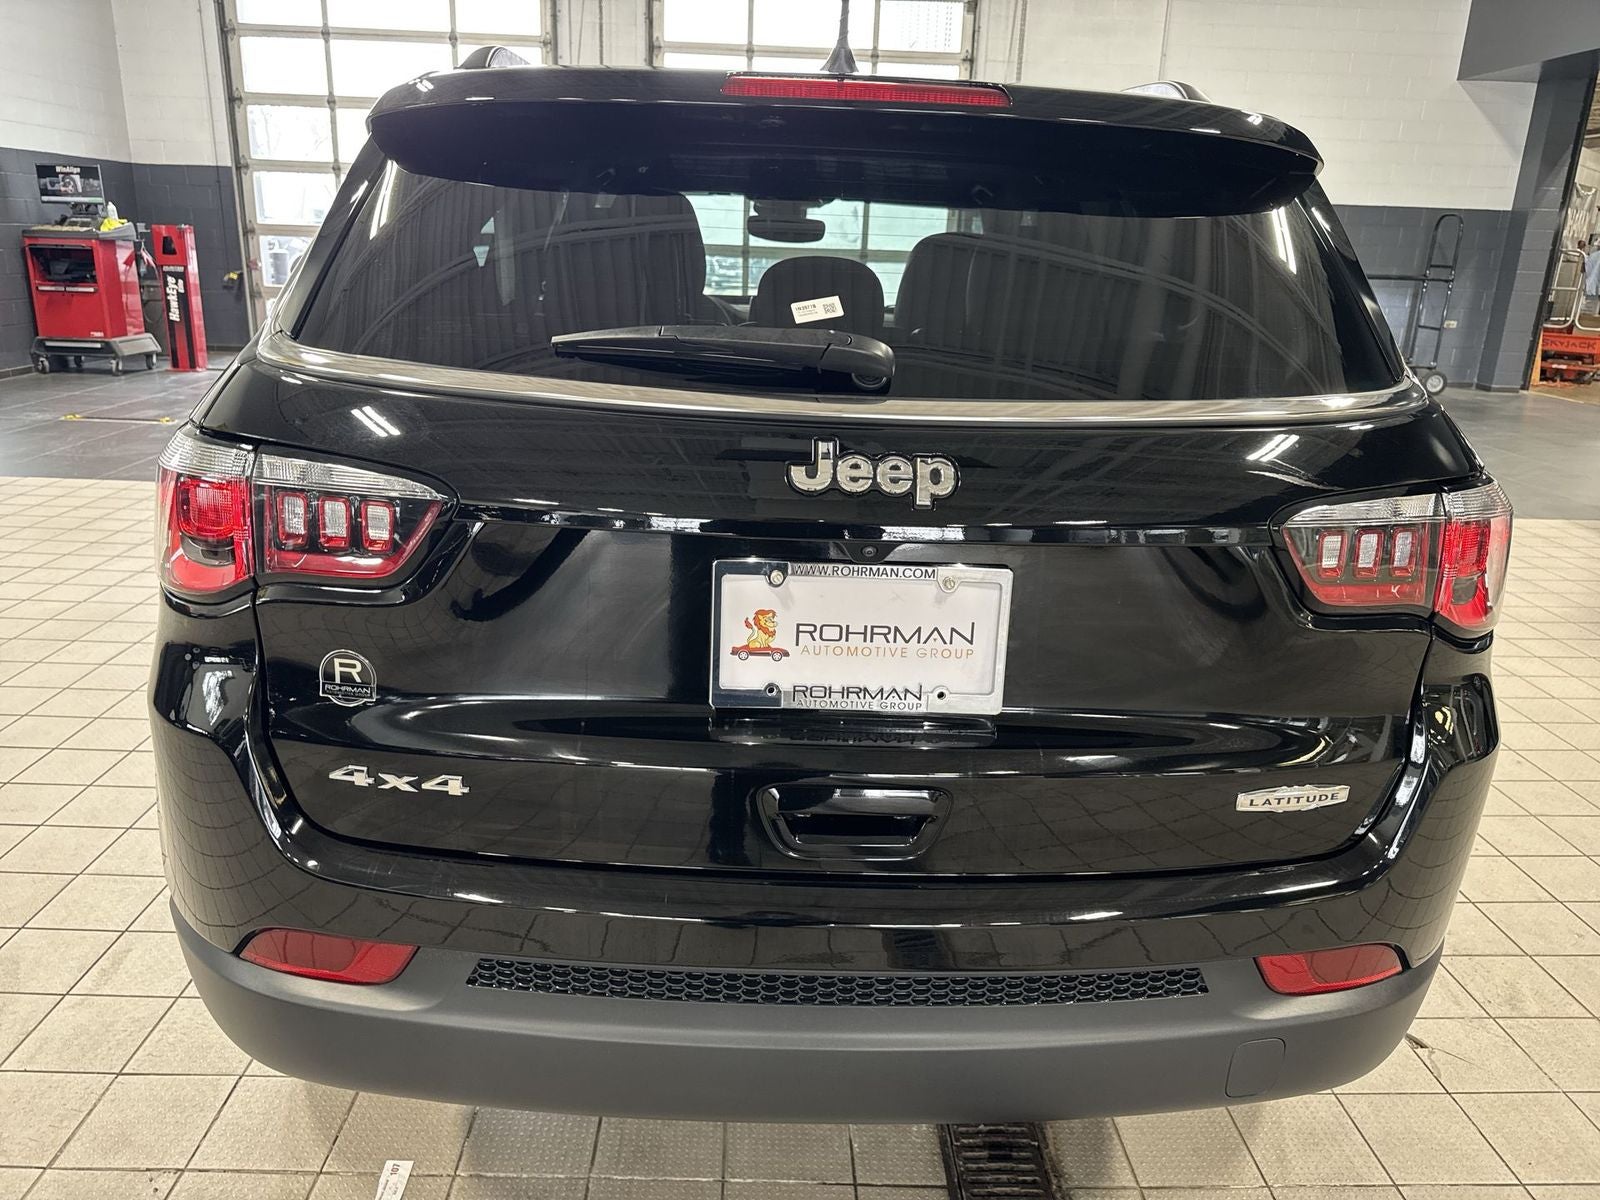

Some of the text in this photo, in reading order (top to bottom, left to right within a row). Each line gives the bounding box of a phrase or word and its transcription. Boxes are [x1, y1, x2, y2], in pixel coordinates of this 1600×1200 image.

[166, 274, 181, 322] HawkEye
[786, 437, 960, 510] Jeep
[792, 565, 936, 579] WWW.ROHRMAN.COM
[795, 622, 975, 646] ROHRMAN
[800, 644, 975, 659] AUTOMOTIVE GROUP
[334, 657, 362, 684] R
[324, 684, 371, 694] ROHRMAN
[792, 684, 923, 702] ROHRMAN
[796, 699, 922, 711] AUTOMOTIVE GROUP
[328, 764, 470, 796] 4x4
[1248, 792, 1340, 807] LATITUDE
[390, 1164, 400, 1175] 107
